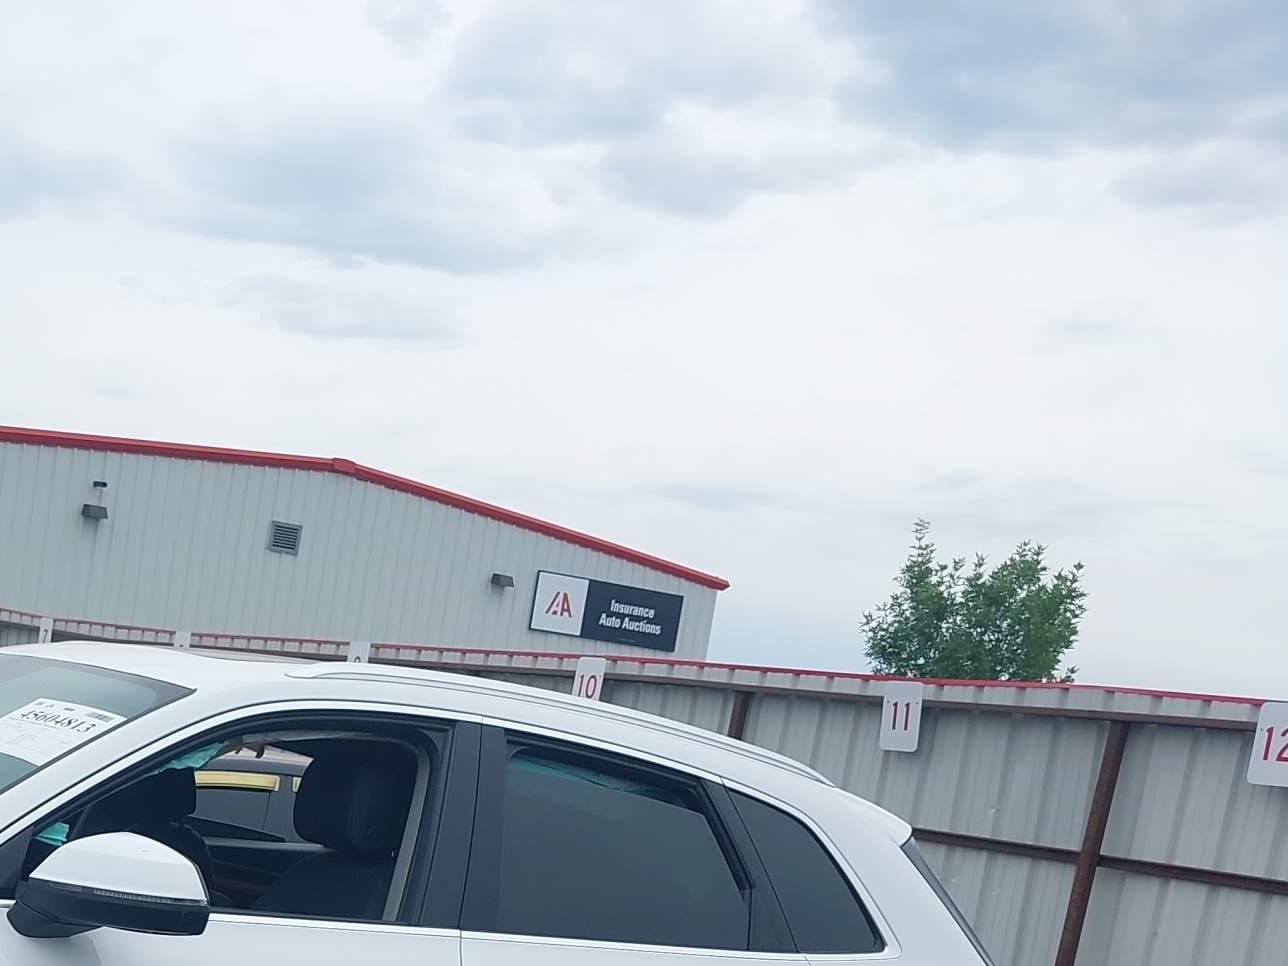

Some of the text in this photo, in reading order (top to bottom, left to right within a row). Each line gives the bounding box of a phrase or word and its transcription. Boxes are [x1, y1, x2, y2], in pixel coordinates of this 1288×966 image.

[610, 599, 655, 619] Insurance
[598, 612, 662, 636] Auto Auctions
[577, 673, 598, 699] 10
[20, 708, 97, 734] 45604813
[891, 701, 911, 732] 11
